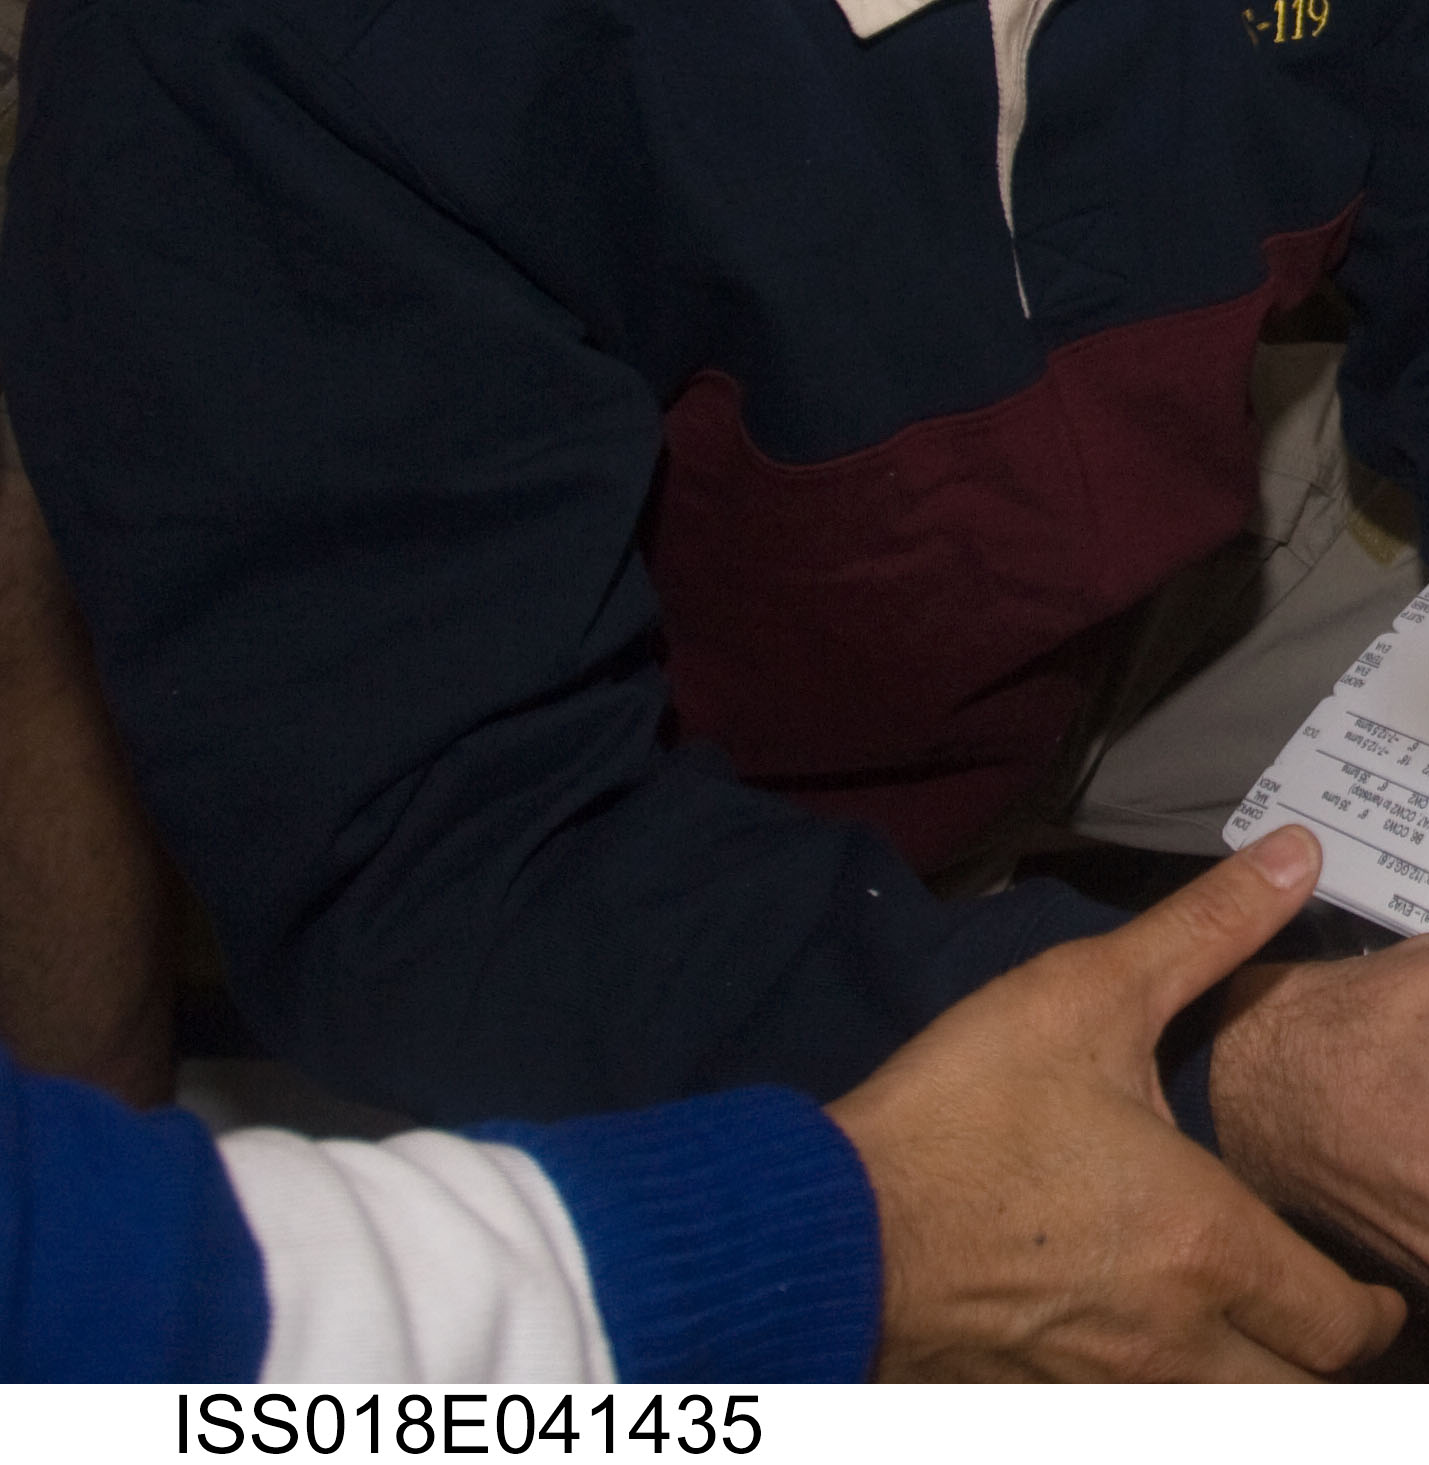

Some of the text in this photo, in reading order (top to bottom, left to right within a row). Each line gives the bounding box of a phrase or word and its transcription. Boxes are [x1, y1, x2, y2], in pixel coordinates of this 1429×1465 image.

[1356, 770, 1371, 785] 35
[1336, 796, 1351, 812] 35
[1385, 893, 1416, 918] EVA2
